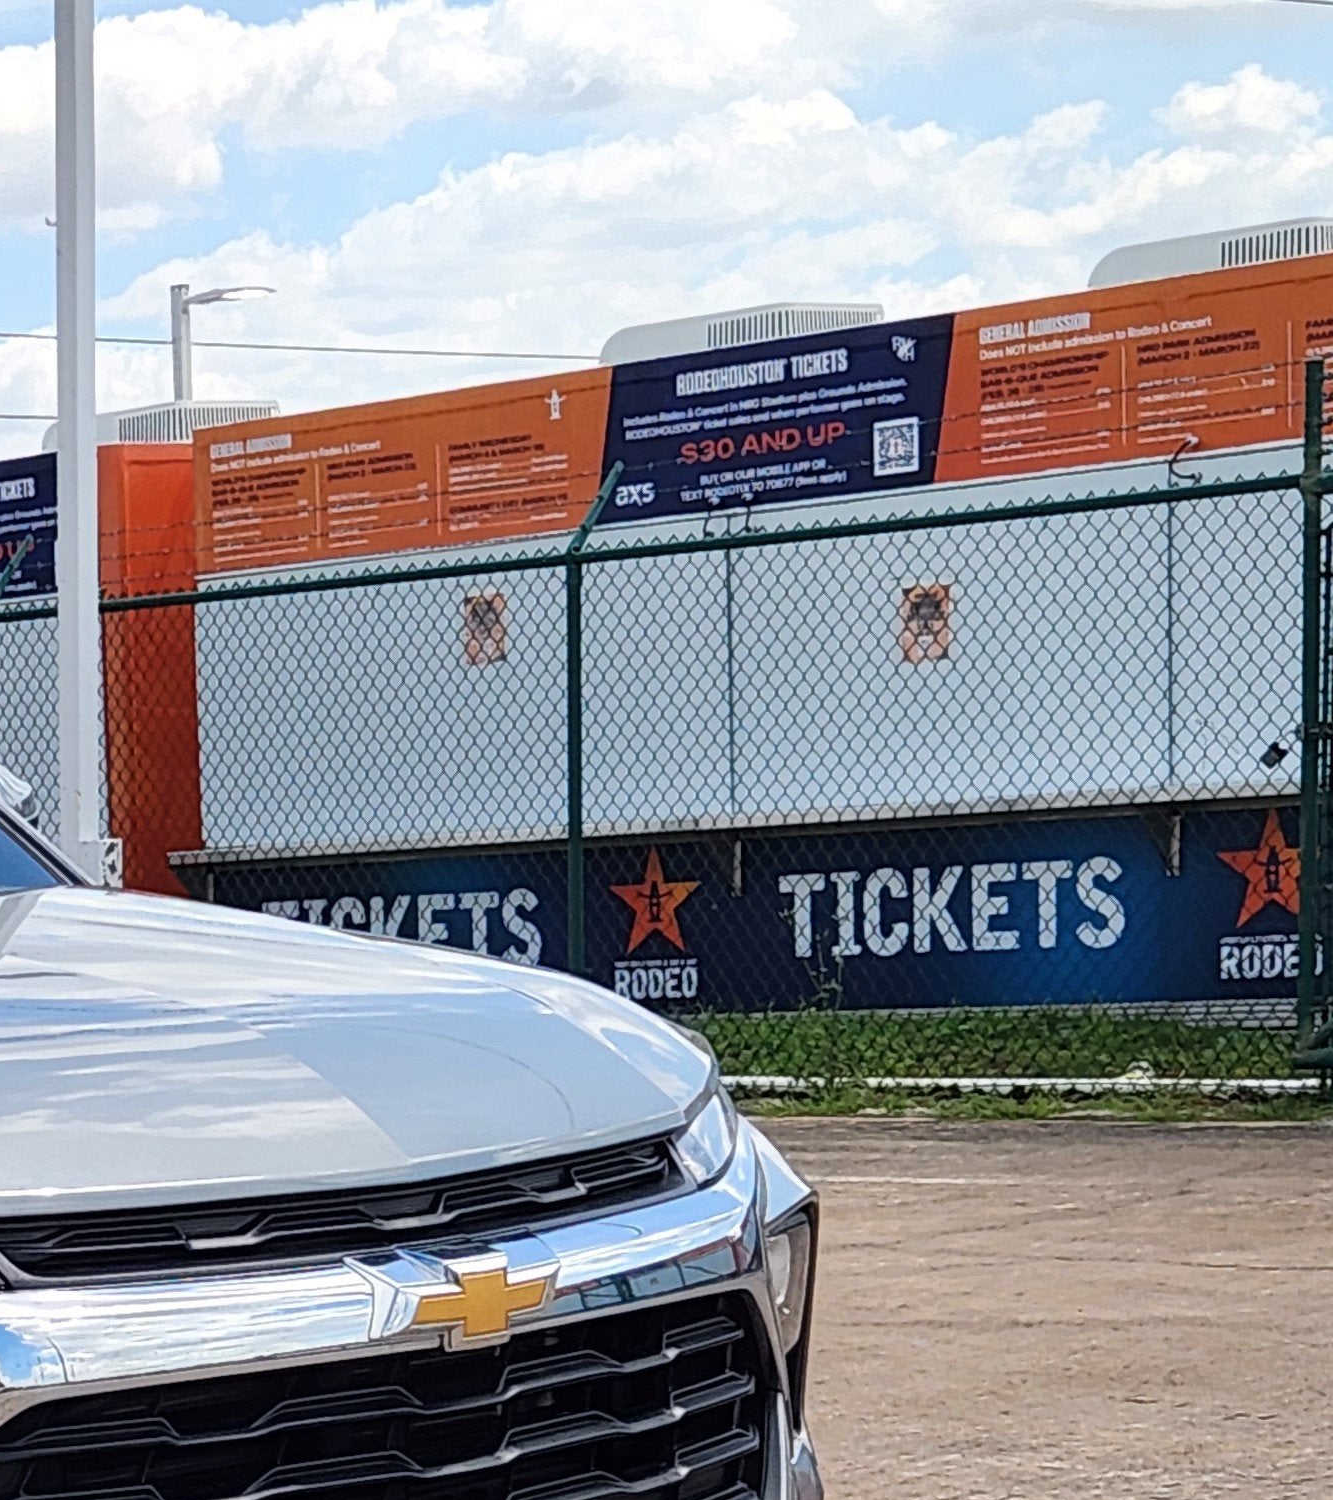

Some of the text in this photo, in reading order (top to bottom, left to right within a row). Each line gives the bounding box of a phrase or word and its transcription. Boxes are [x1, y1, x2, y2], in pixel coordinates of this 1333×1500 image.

[790, 347, 848, 380] TICKETS
[1005, 343, 1027, 356] NOT
[741, 428, 801, 457] AND
[807, 421, 846, 447] UP
[778, 856, 1126, 958] TICKETS
[262, 888, 542, 966] KETS
[614, 966, 698, 999] RODEO
